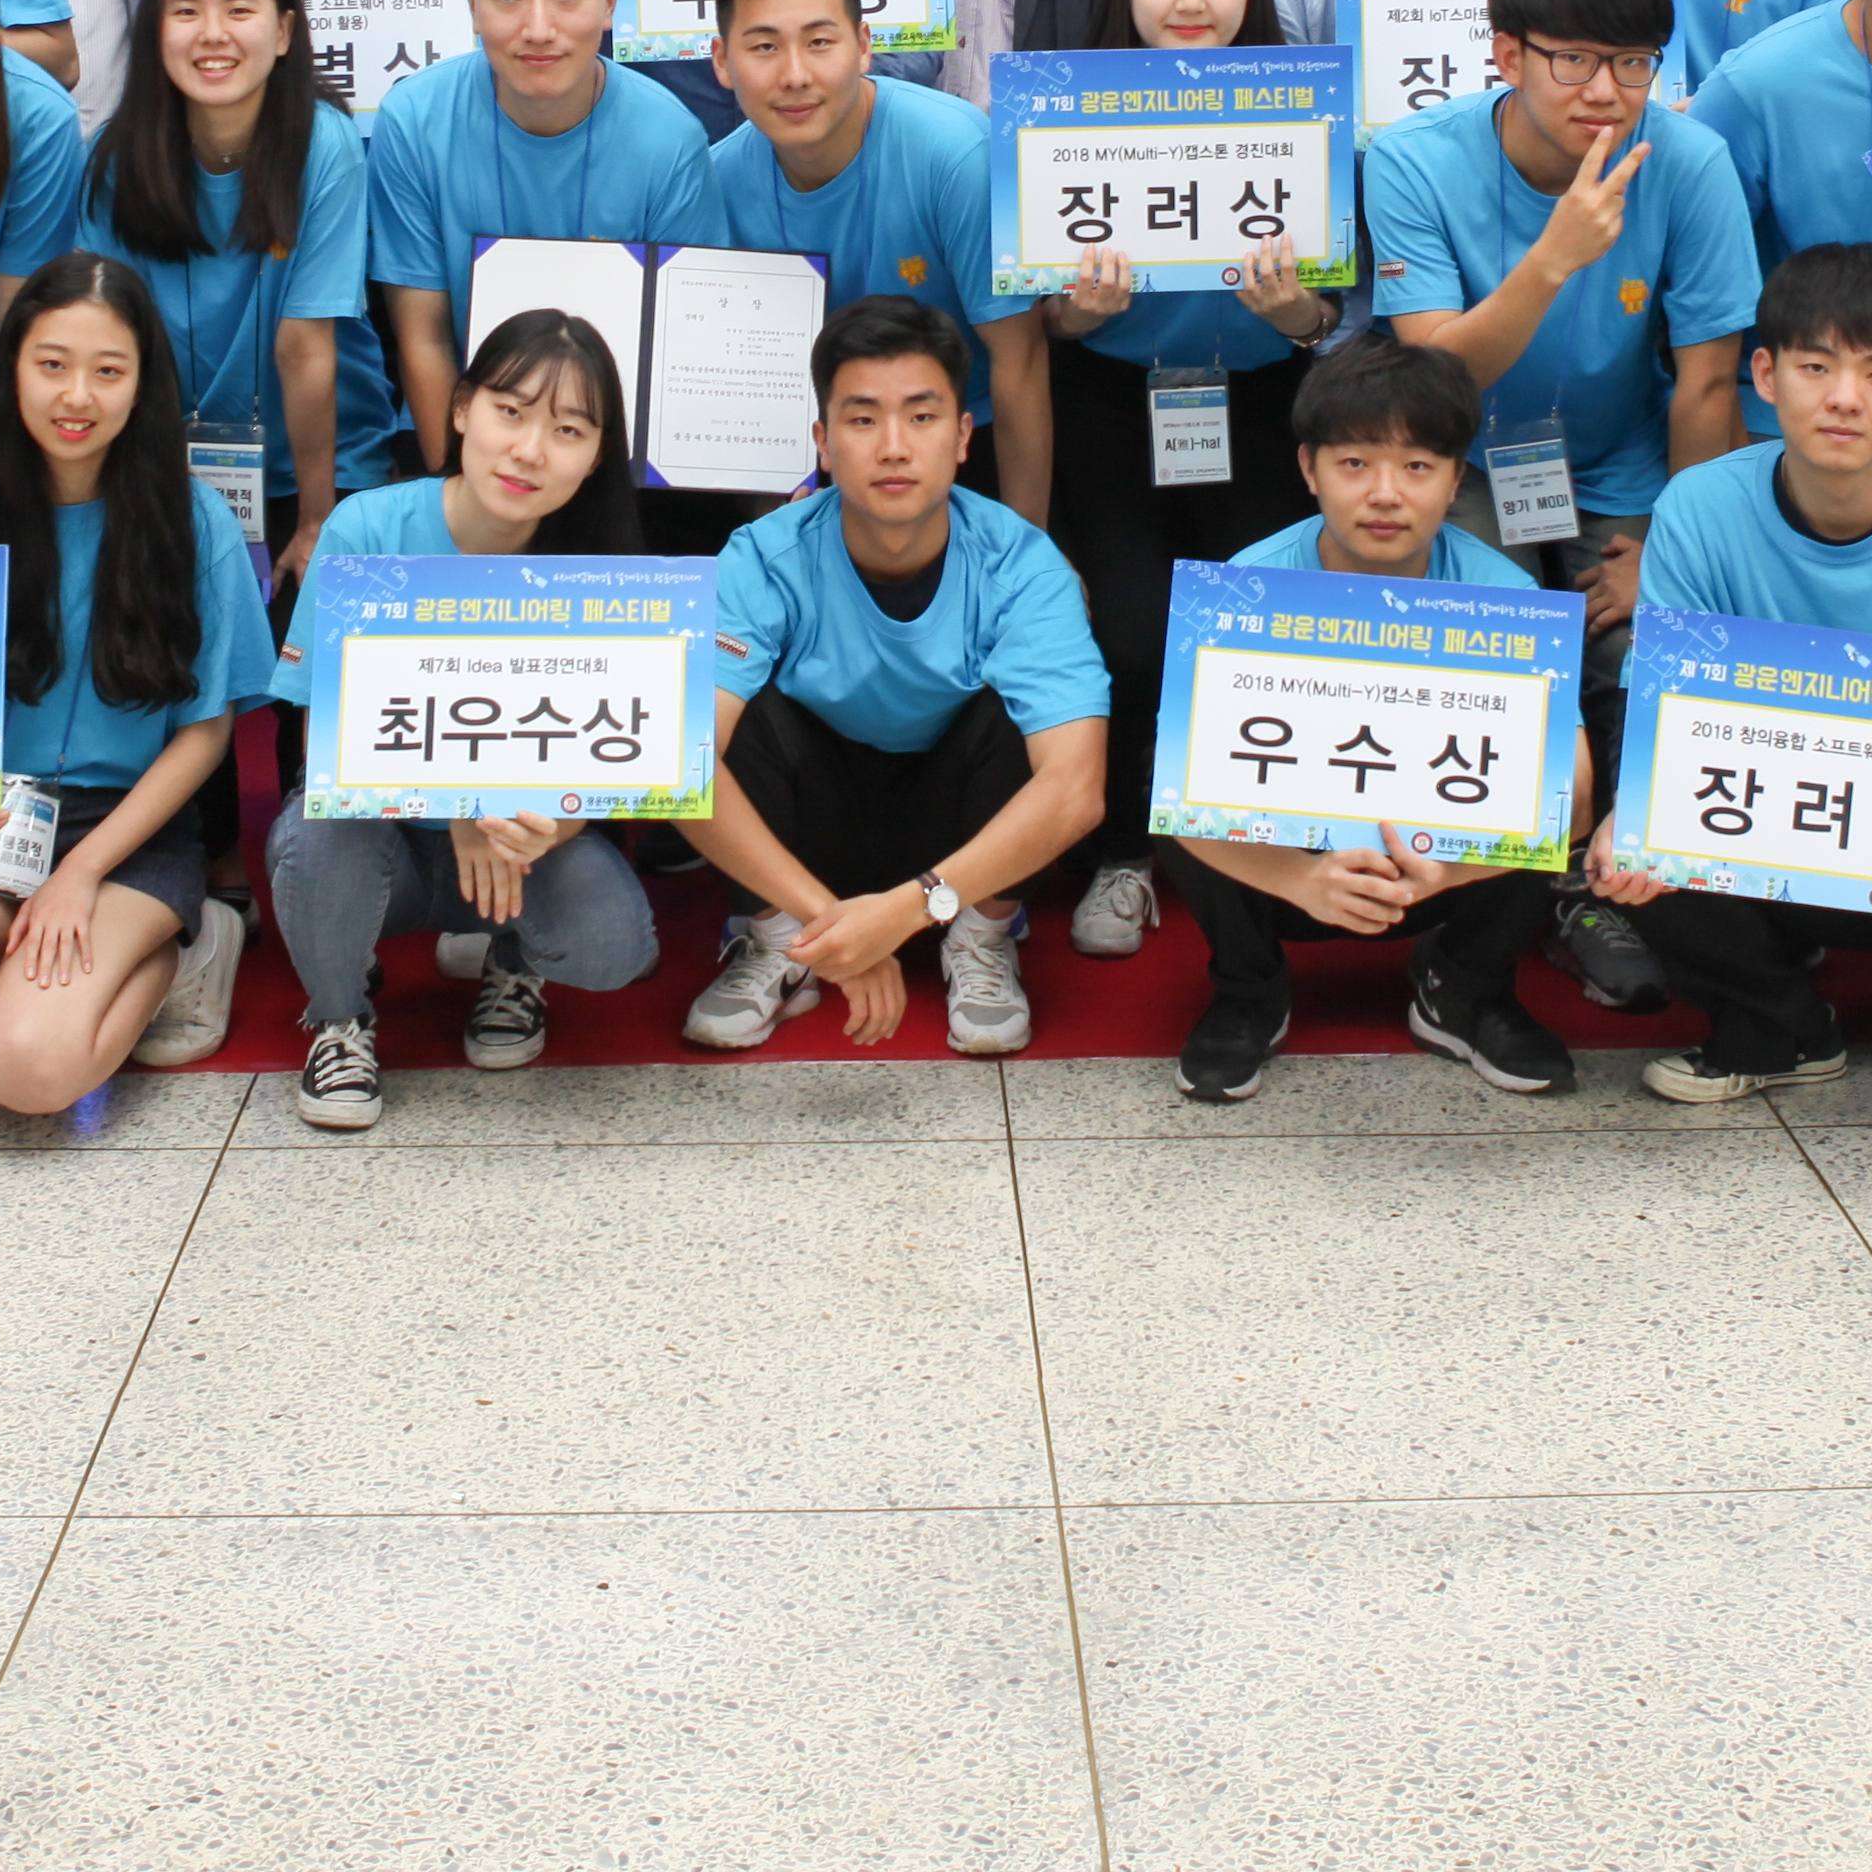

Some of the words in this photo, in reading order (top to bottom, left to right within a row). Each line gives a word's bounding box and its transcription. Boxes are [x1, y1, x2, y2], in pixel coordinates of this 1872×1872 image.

[1052, 148, 1090, 163] 2018
[1234, 141, 1294, 159] 경진대회
[1536, 494, 1569, 510] MODI
[418, 657, 461, 675] 제7회
[467, 658, 502, 674] Idea
[509, 656, 609, 676] 발표경연대회
[1232, 673, 1274, 692] 2018
[1440, 689, 1507, 714] 경진대회
[373, 696, 650, 763] 최우수상
[1691, 720, 1733, 742] 2018
[1740, 725, 1807, 751] 창의융합
